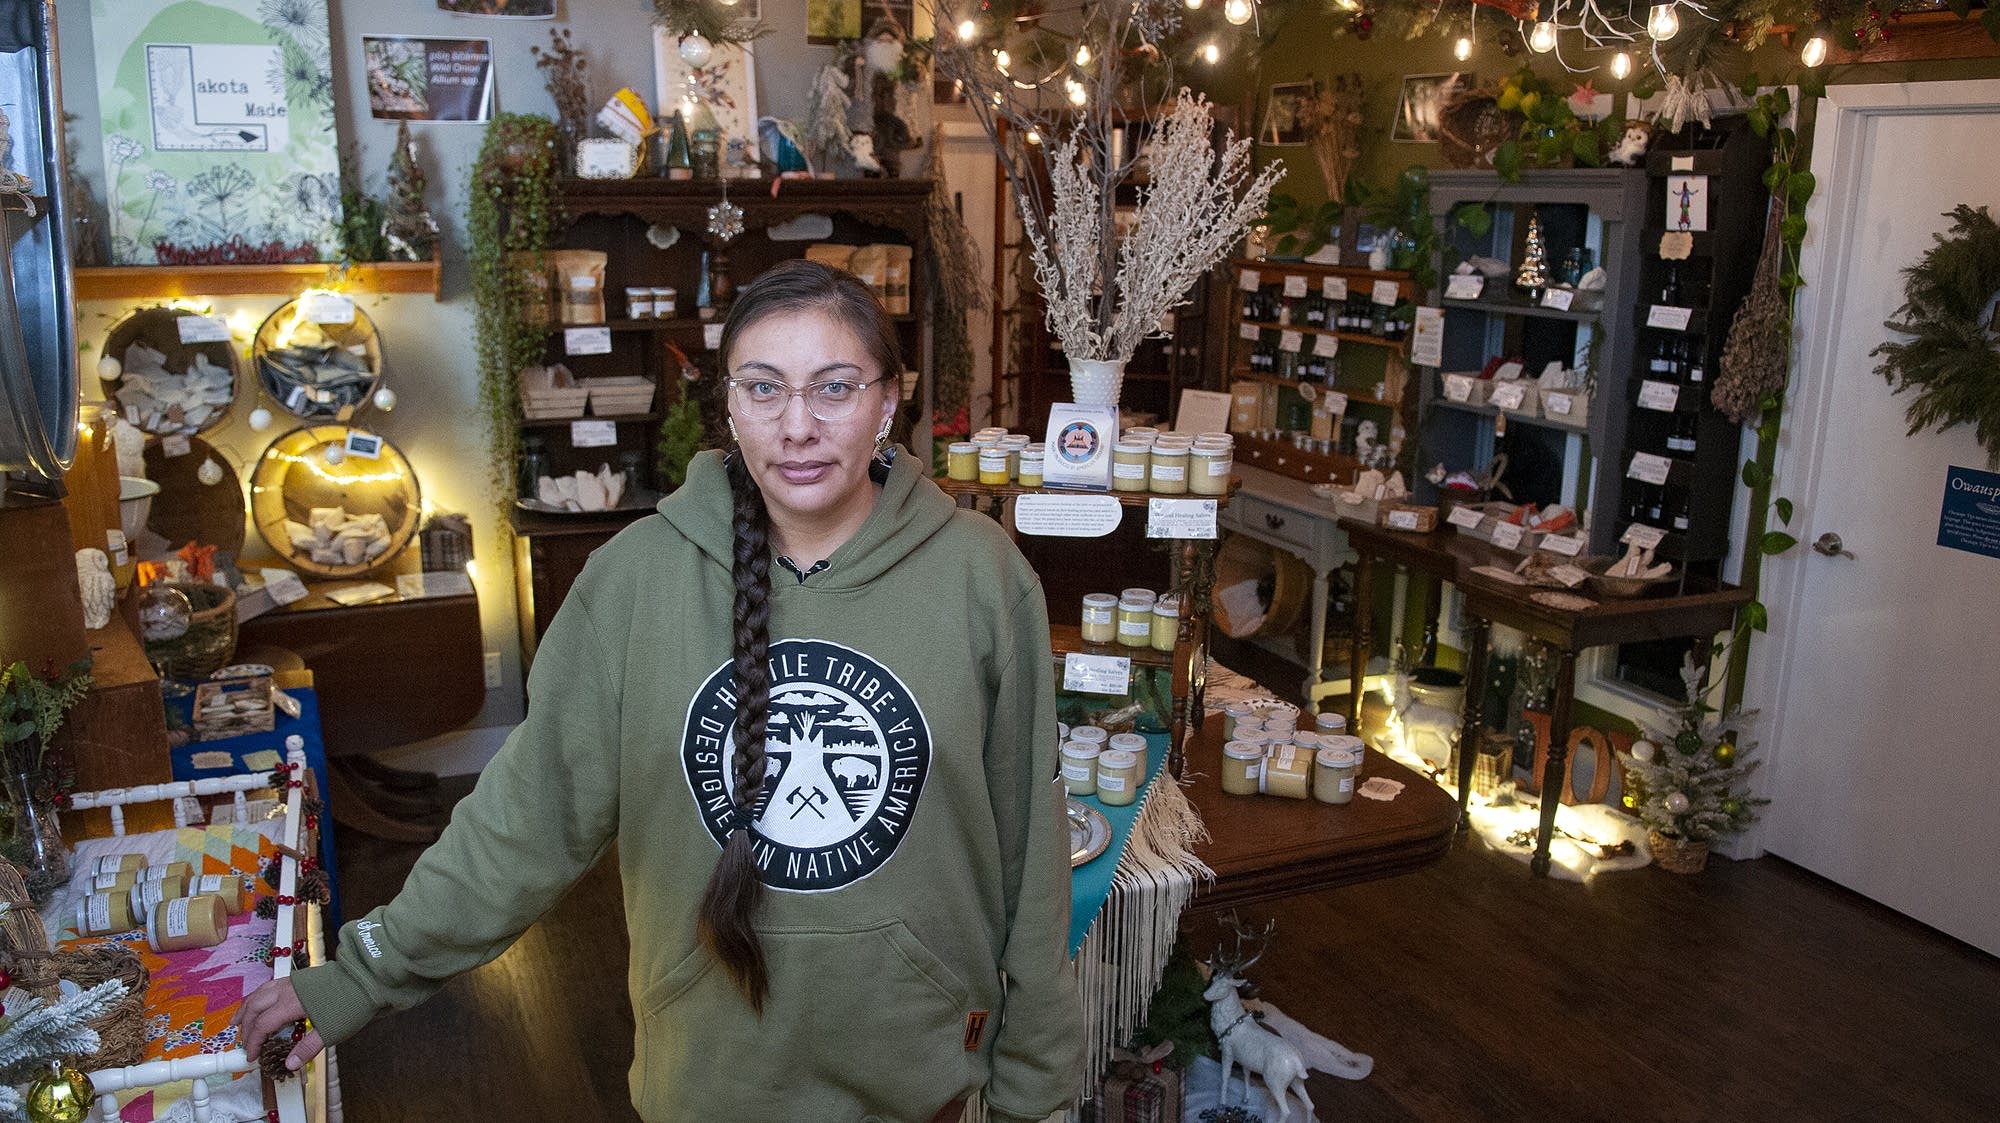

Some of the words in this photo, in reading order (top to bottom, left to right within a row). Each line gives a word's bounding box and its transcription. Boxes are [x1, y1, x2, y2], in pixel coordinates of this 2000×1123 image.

[245, 102, 287, 117] Made
[716, 653, 809, 710] HTLE
[825, 656, 895, 713] TRIBE
[752, 839, 776, 871] IN
[786, 832, 880, 879] NATIVE
[877, 717, 918, 834] AMERICA
[357, 919, 383, 958] America
